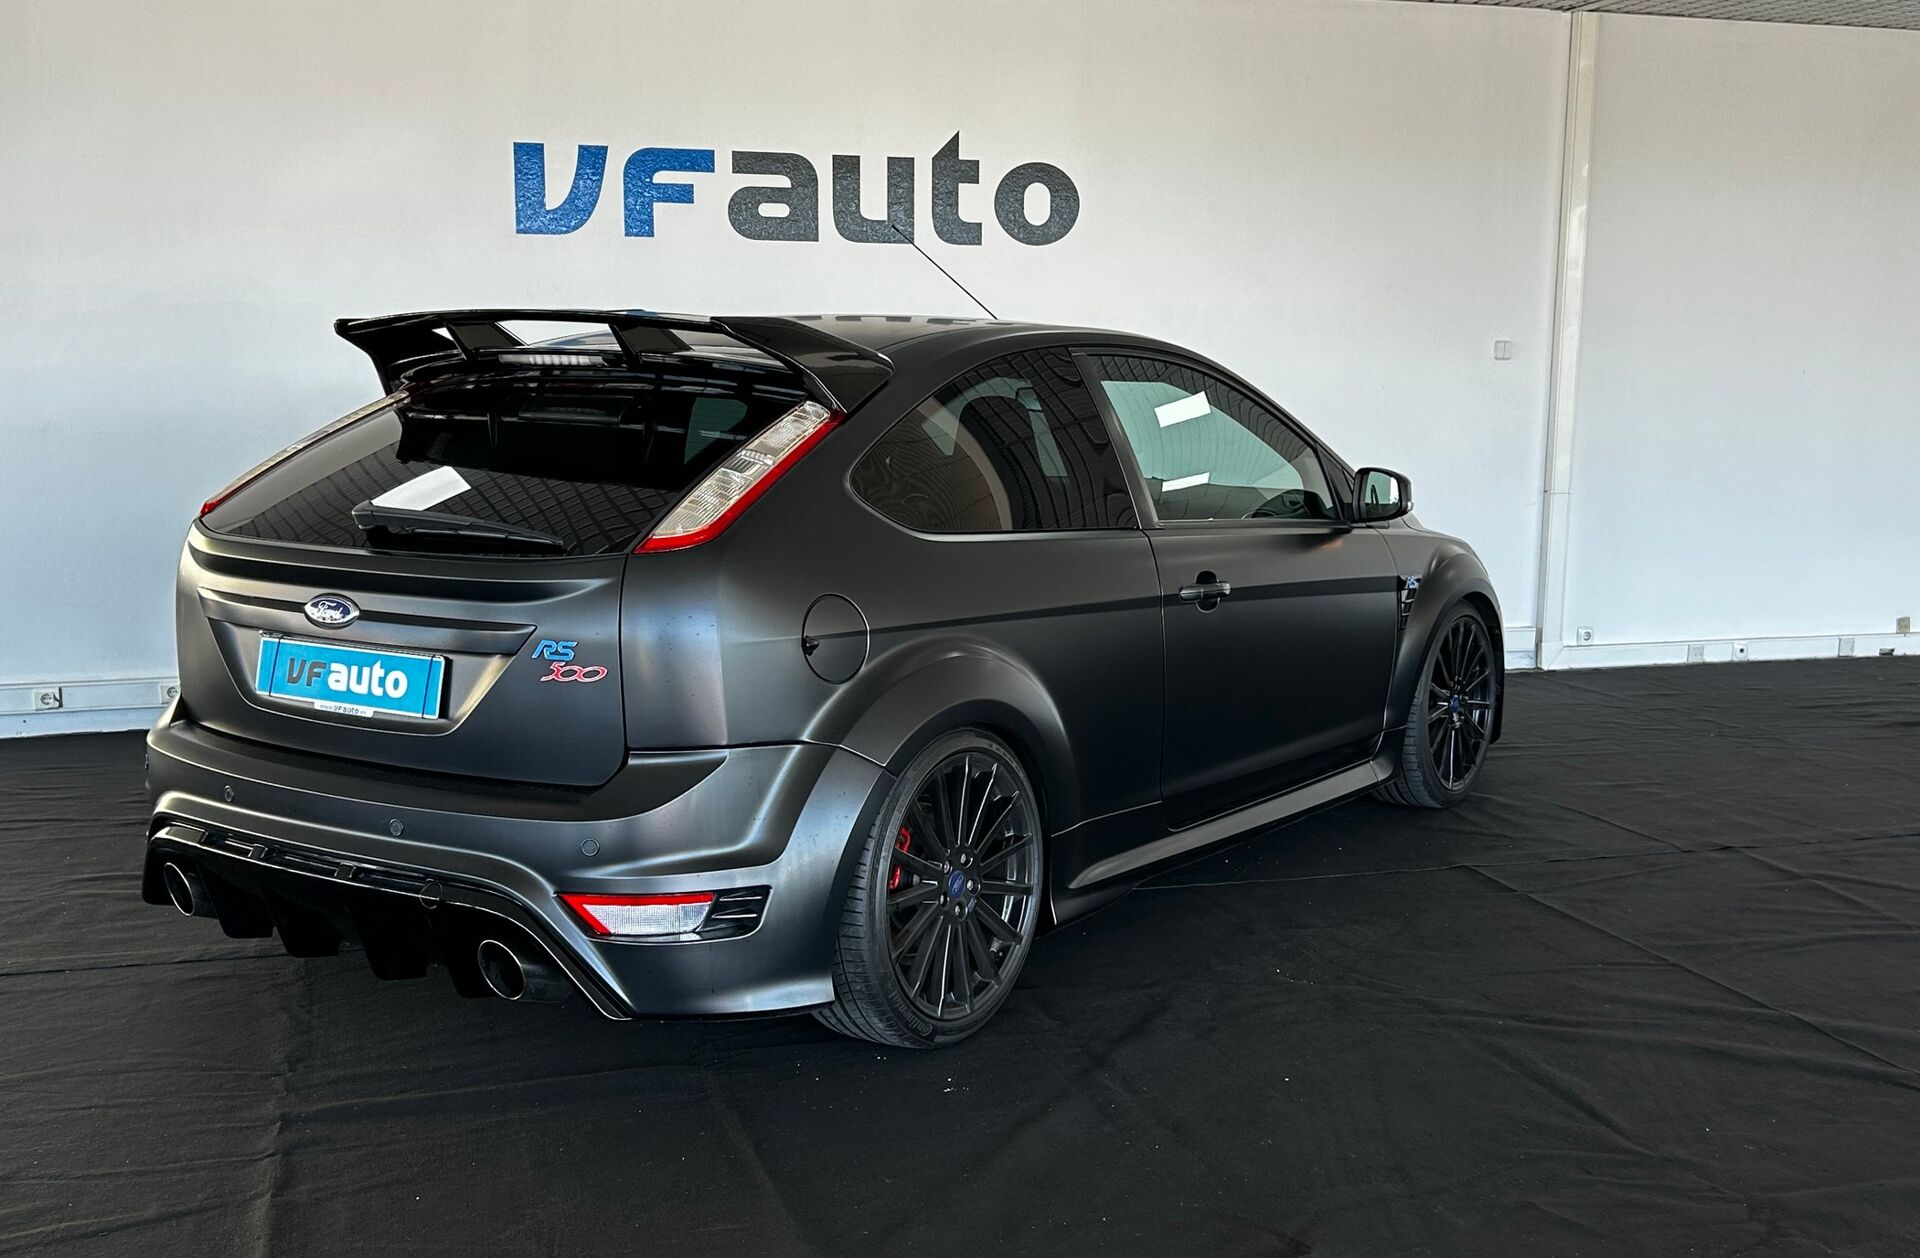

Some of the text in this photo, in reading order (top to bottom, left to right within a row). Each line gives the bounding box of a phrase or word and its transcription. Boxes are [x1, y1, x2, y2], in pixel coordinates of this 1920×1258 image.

[314, 600, 344, 621] Ford
[532, 640, 577, 661] RS
[540, 661, 608, 682] 500
